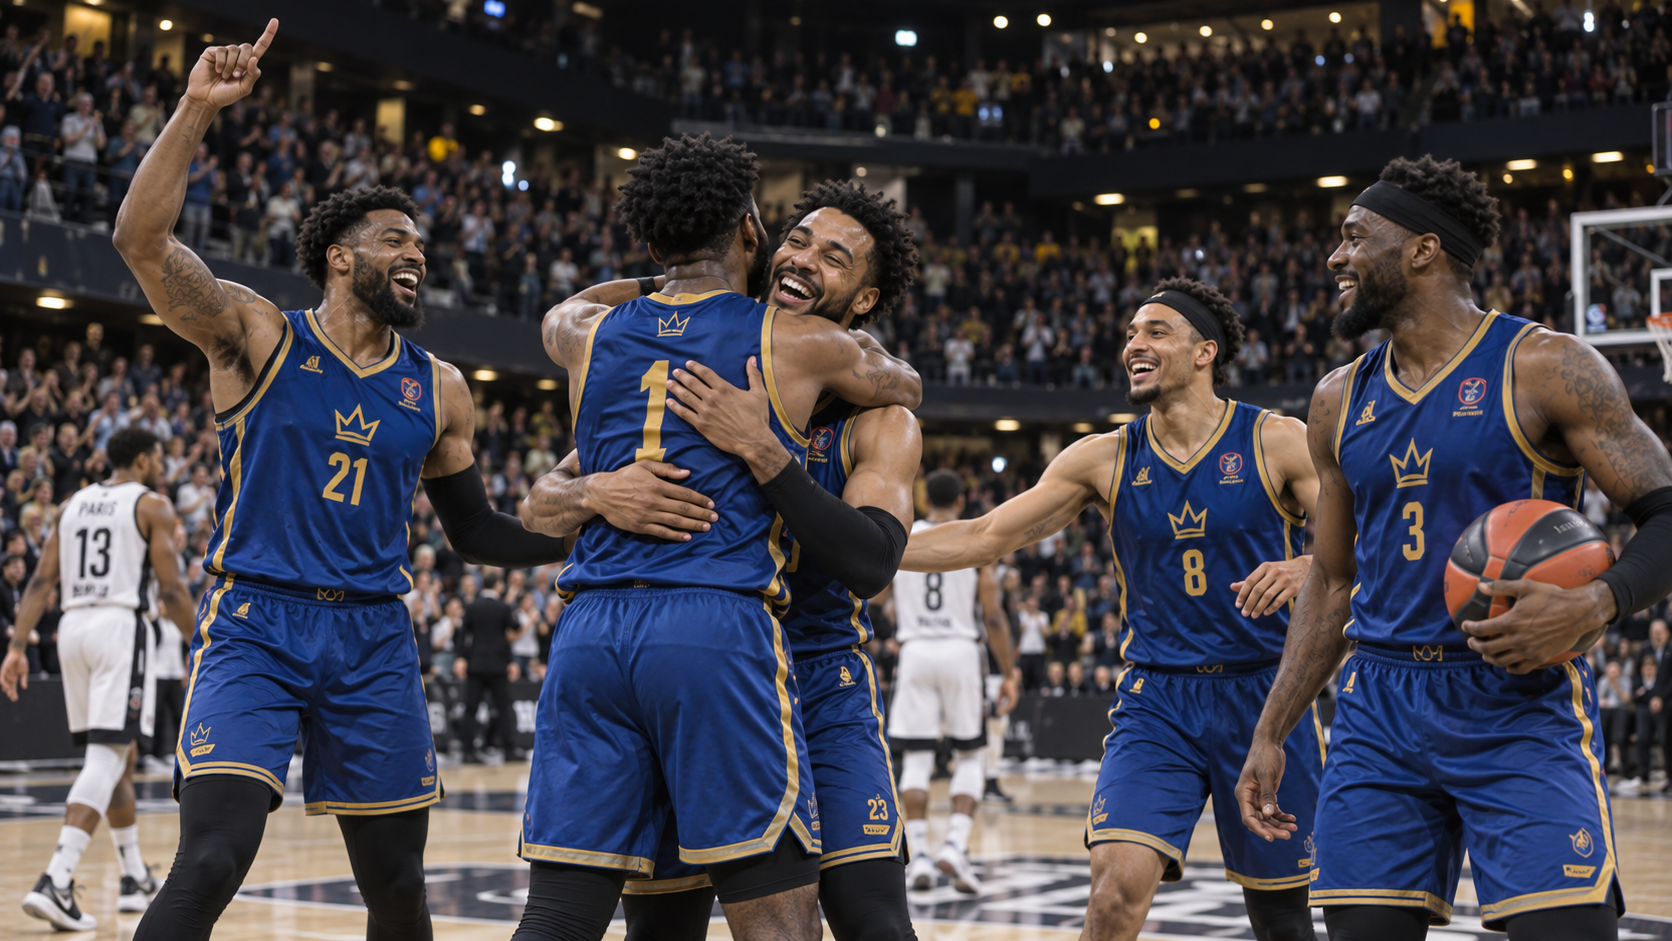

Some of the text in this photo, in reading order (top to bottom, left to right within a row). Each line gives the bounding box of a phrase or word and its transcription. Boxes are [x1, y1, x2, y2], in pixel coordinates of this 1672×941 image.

[635, 360, 669, 462] 1
[322, 452, 368, 506] 21
[76, 527, 111, 578] 13
[1402, 501, 1425, 561] 3
[925, 572, 943, 612] 8
[1182, 548, 1208, 597] 8
[867, 798, 889, 821] 23
